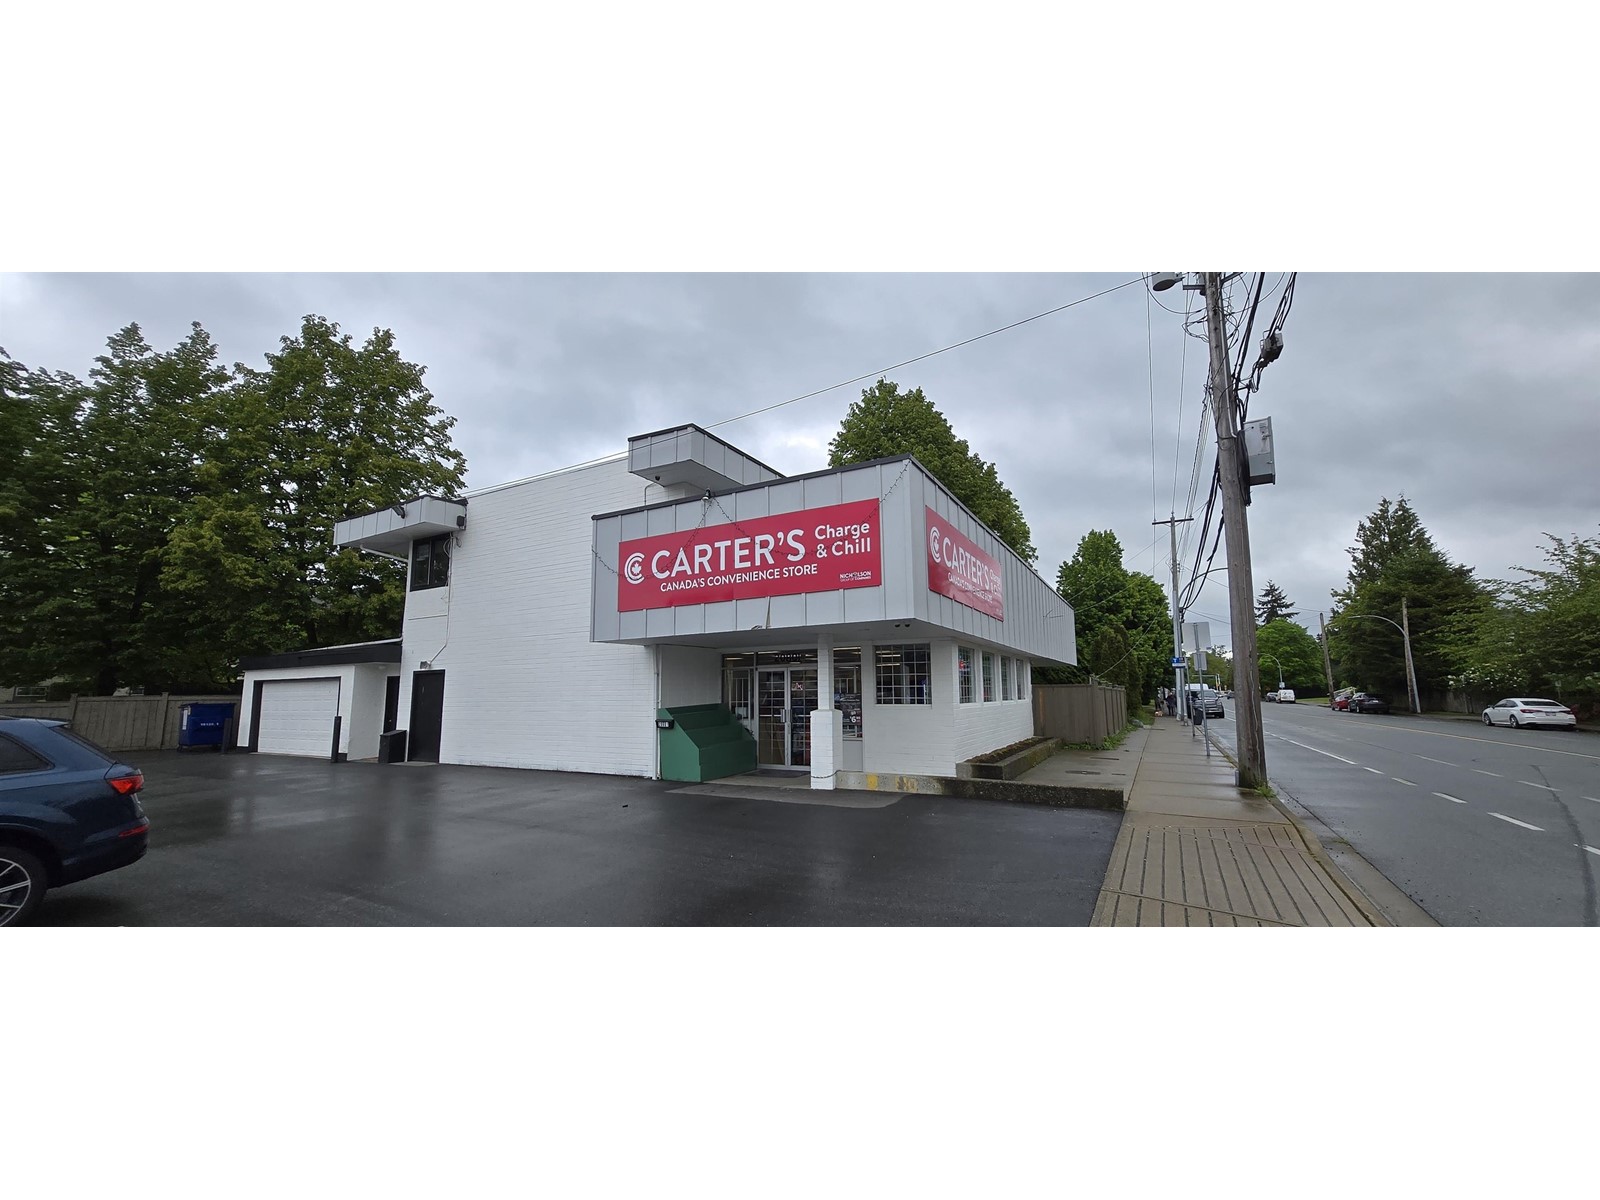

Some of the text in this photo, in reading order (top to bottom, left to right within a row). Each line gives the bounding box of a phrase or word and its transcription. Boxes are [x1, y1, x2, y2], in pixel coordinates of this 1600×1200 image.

[815, 523, 870, 539] Charge
[651, 529, 806, 579] CARTER'S
[816, 537, 871, 558] & Chill
[660, 563, 818, 592] CANADA'S CONVENIENCE STORE
[943, 537, 990, 590] CARTER'S
